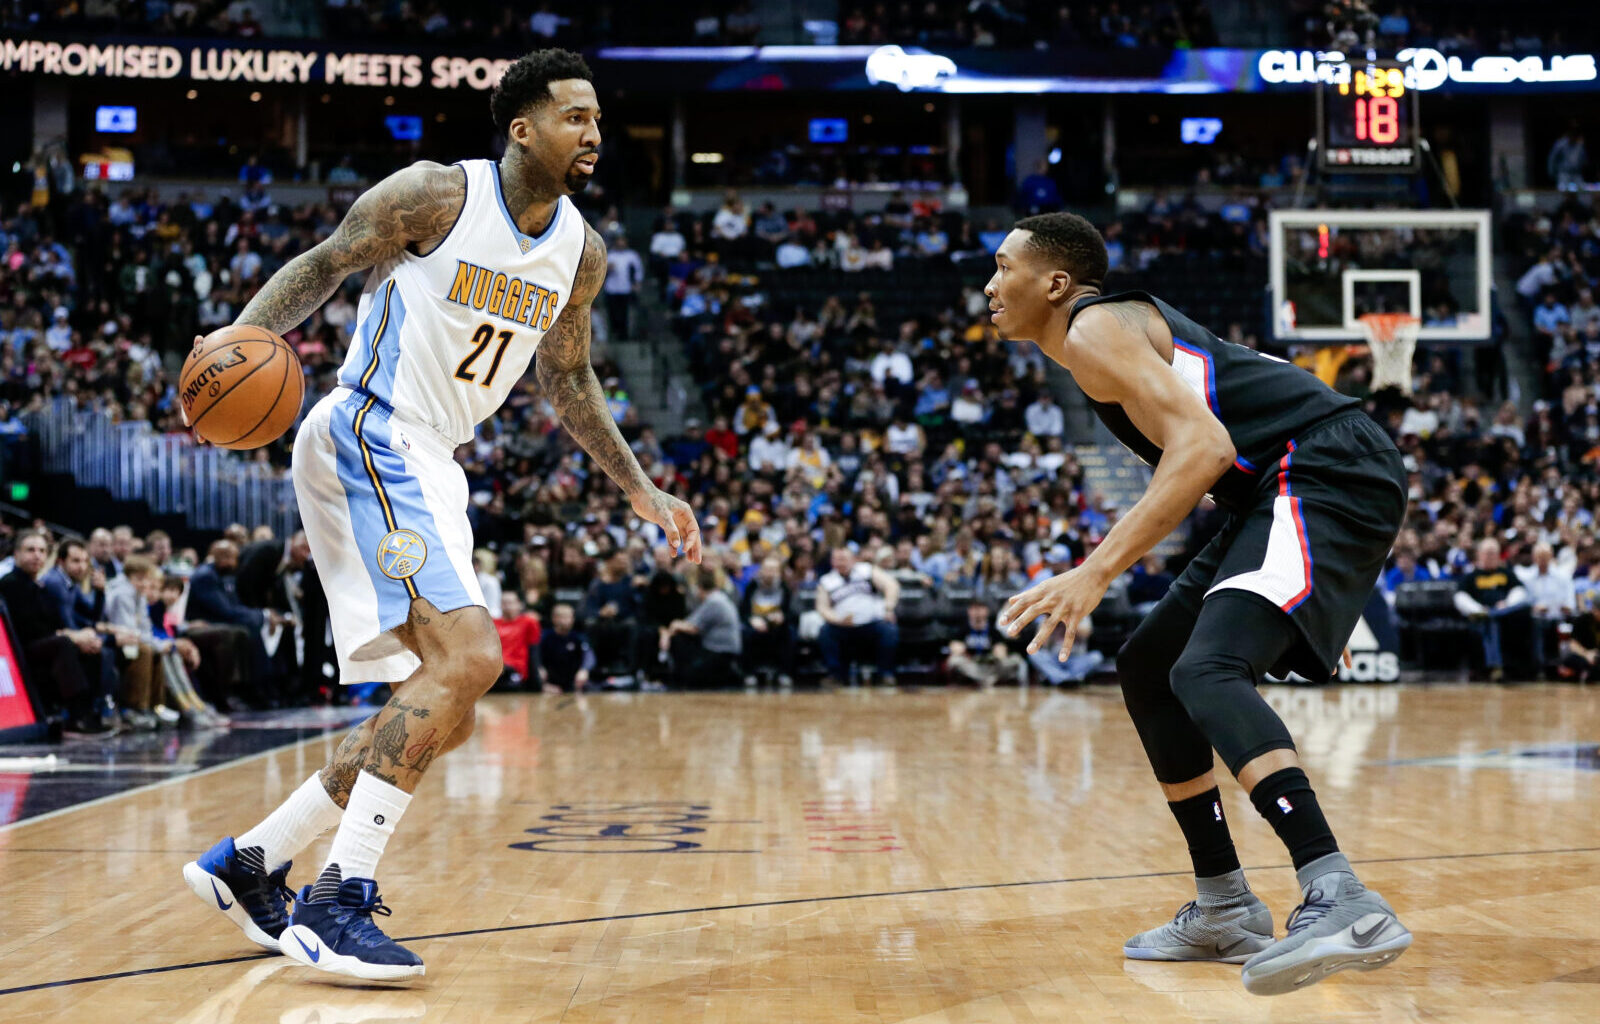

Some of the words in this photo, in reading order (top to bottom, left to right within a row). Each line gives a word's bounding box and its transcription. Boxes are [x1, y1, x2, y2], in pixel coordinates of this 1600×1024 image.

[0, 39, 183, 79] MPROMISED
[190, 47, 316, 84] LUXURY
[325, 53, 423, 88] MEETS
[431, 55, 519, 90] SPOR
[1355, 97, 1399, 144] 18
[446, 259, 559, 332] NUGGETS
[182, 345, 248, 411] SPALDING
[454, 321, 516, 389] 21
